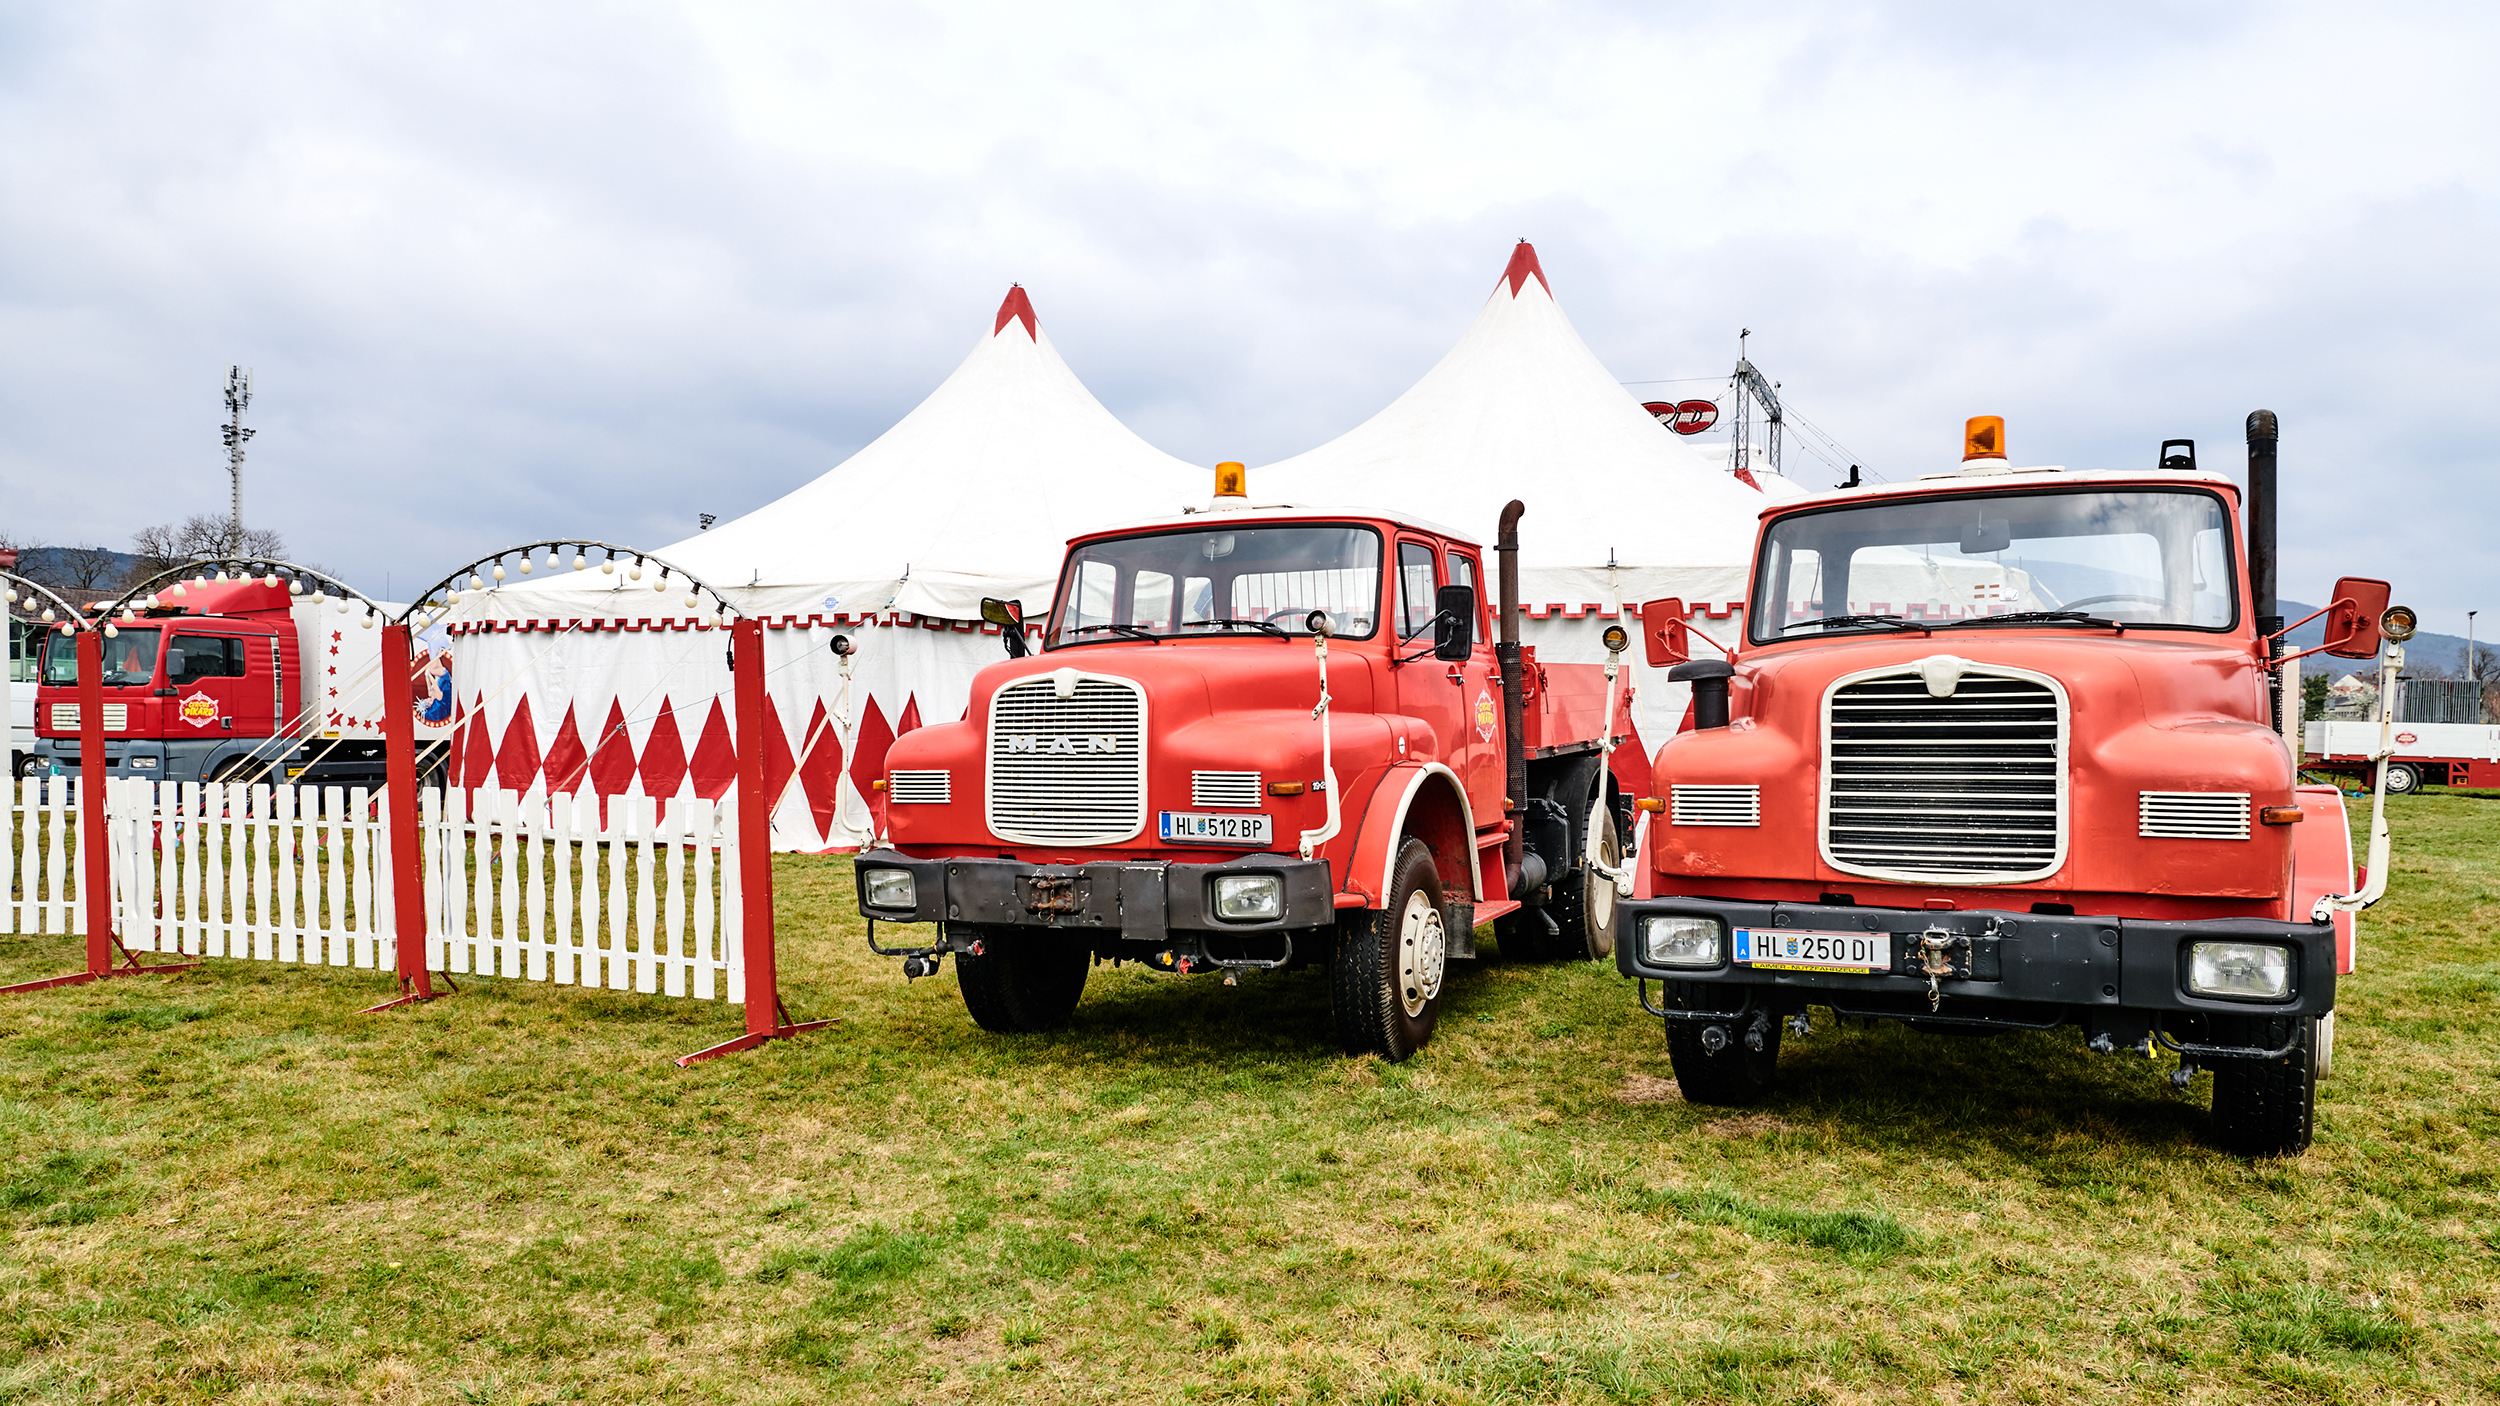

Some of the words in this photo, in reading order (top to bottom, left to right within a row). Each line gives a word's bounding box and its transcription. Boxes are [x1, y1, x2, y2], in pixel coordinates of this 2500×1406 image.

[184, 707, 214, 716] PIKARD
[1008, 734, 1117, 755] MAN
[1176, 817, 1195, 835] HL
[1208, 818, 1237, 837] 512
[1241, 819, 1263, 838] BP
[1739, 948, 1747, 956] A
[1757, 935, 1783, 958] HL
[1802, 937, 1845, 961] 250
[1852, 939, 1874, 962] DI
